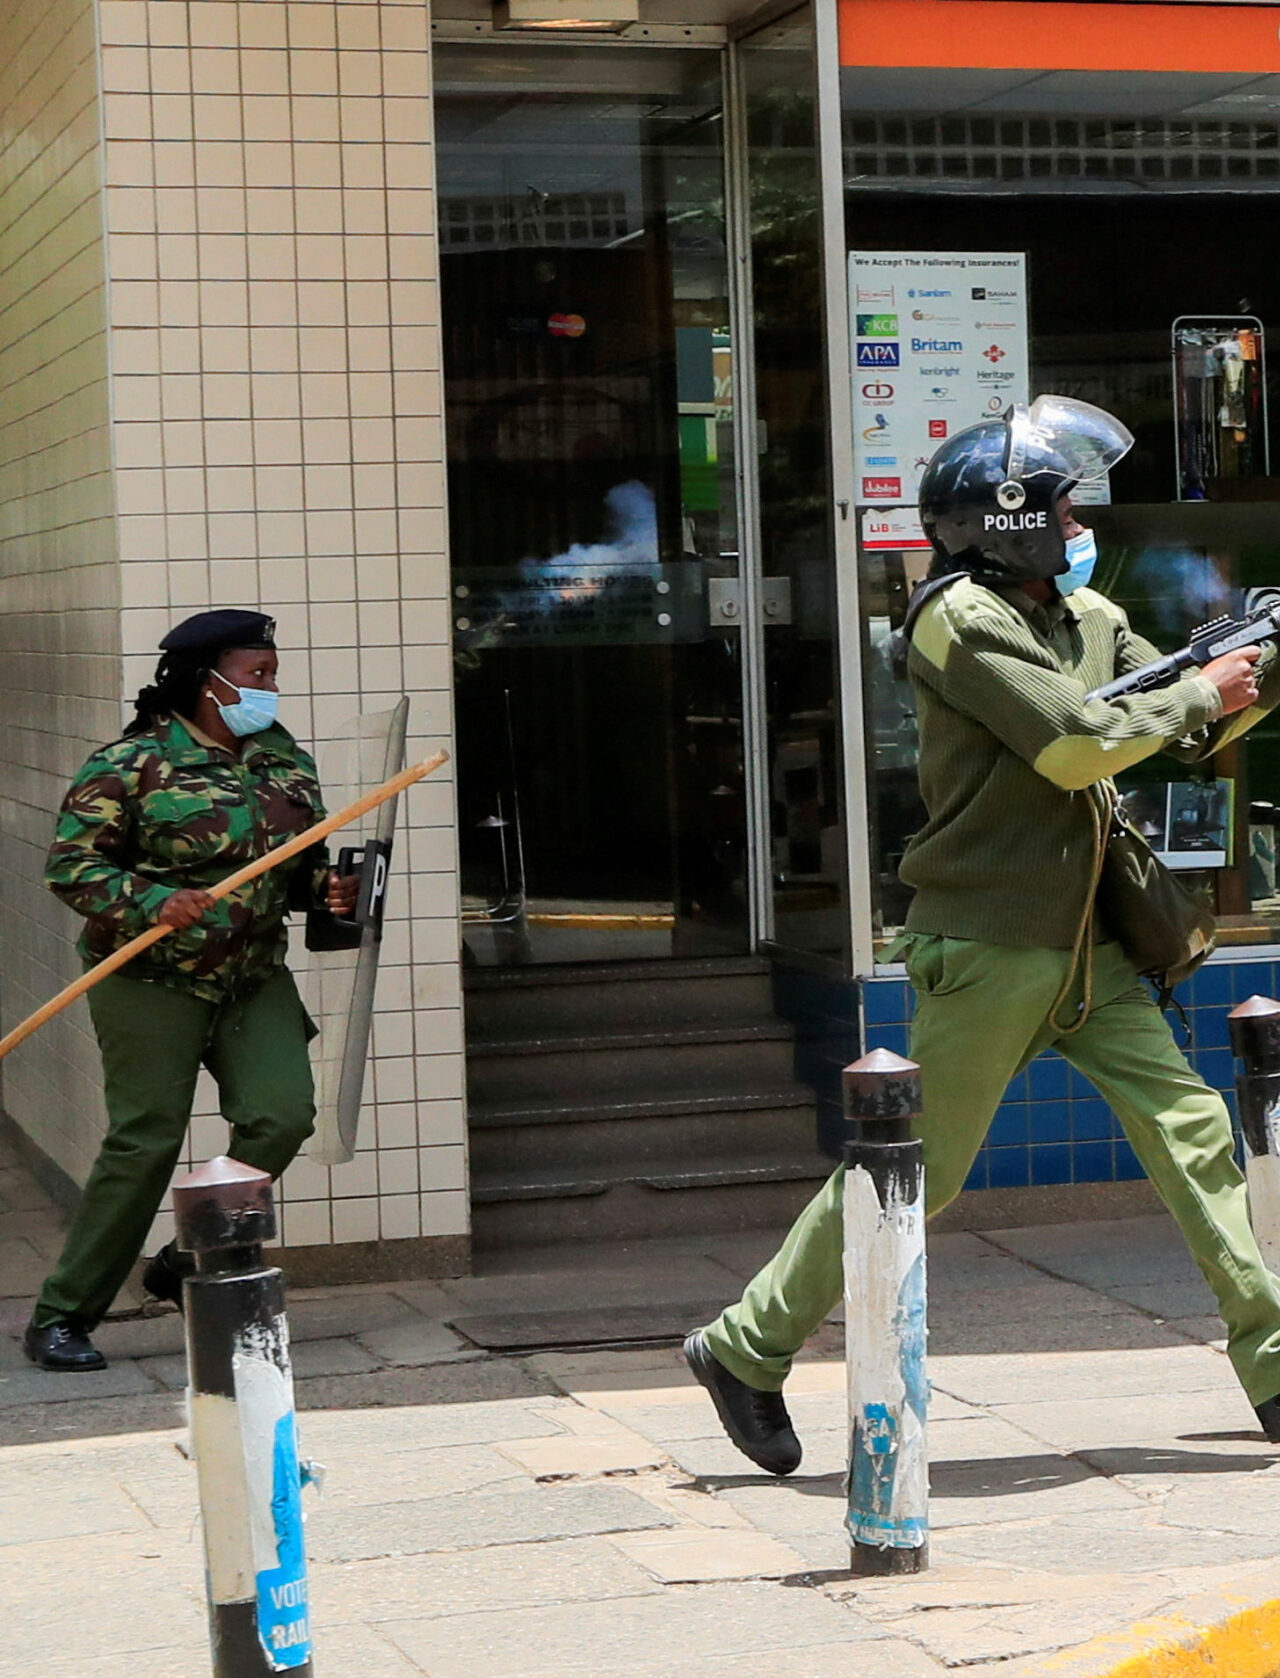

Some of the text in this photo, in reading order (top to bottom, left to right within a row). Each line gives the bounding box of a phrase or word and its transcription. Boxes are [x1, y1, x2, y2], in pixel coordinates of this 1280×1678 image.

[872, 258, 902, 267] Accept
[905, 258, 921, 266] The
[923, 258, 966, 268] Following
[873, 320, 898, 332] KCB
[911, 337, 963, 351] Britam
[860, 345, 897, 360] APA
[977, 370, 1015, 381] Heritage
[984, 511, 1047, 531] POLICE
